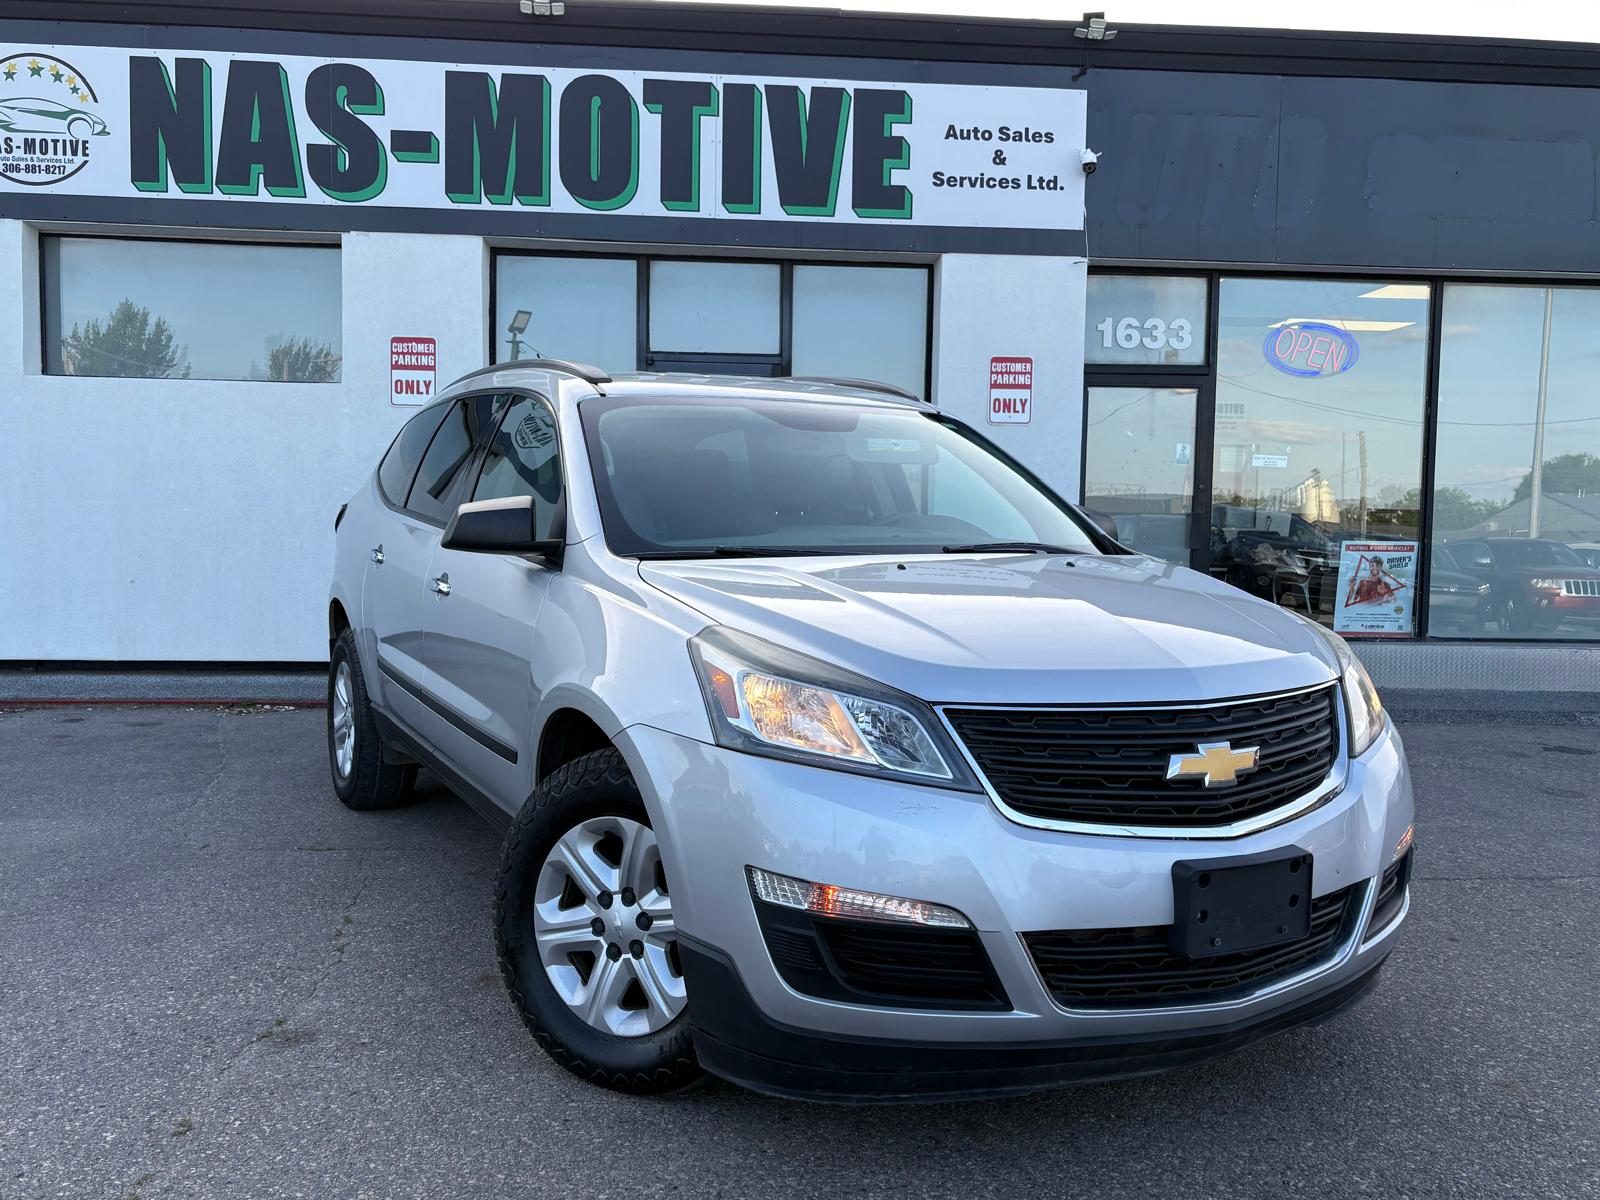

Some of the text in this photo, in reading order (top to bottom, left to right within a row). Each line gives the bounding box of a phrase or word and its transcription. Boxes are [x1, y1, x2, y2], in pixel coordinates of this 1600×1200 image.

[129, 55, 913, 220] NAS-MOTIVE
[944, 124, 1055, 144] Auto Sales
[0, 137, 89, 157] S-MOTIVE
[992, 149, 1007, 166] &
[2, 163, 66, 175] 306-881-8217
[932, 171, 1065, 191] Services Ltd.
[1096, 317, 1192, 350] 1633
[392, 342, 435, 353] CUSTOMER
[1275, 328, 1346, 372] OPEN
[392, 354, 435, 366] PARKING
[991, 362, 1031, 373] CUSTOMER
[394, 379, 432, 395] ONLY
[991, 374, 1031, 385] PARKING
[992, 397, 1028, 414] ONLY
[1386, 555, 1412, 565] DRIVER'S
[1388, 562, 1409, 570] SHIELD
